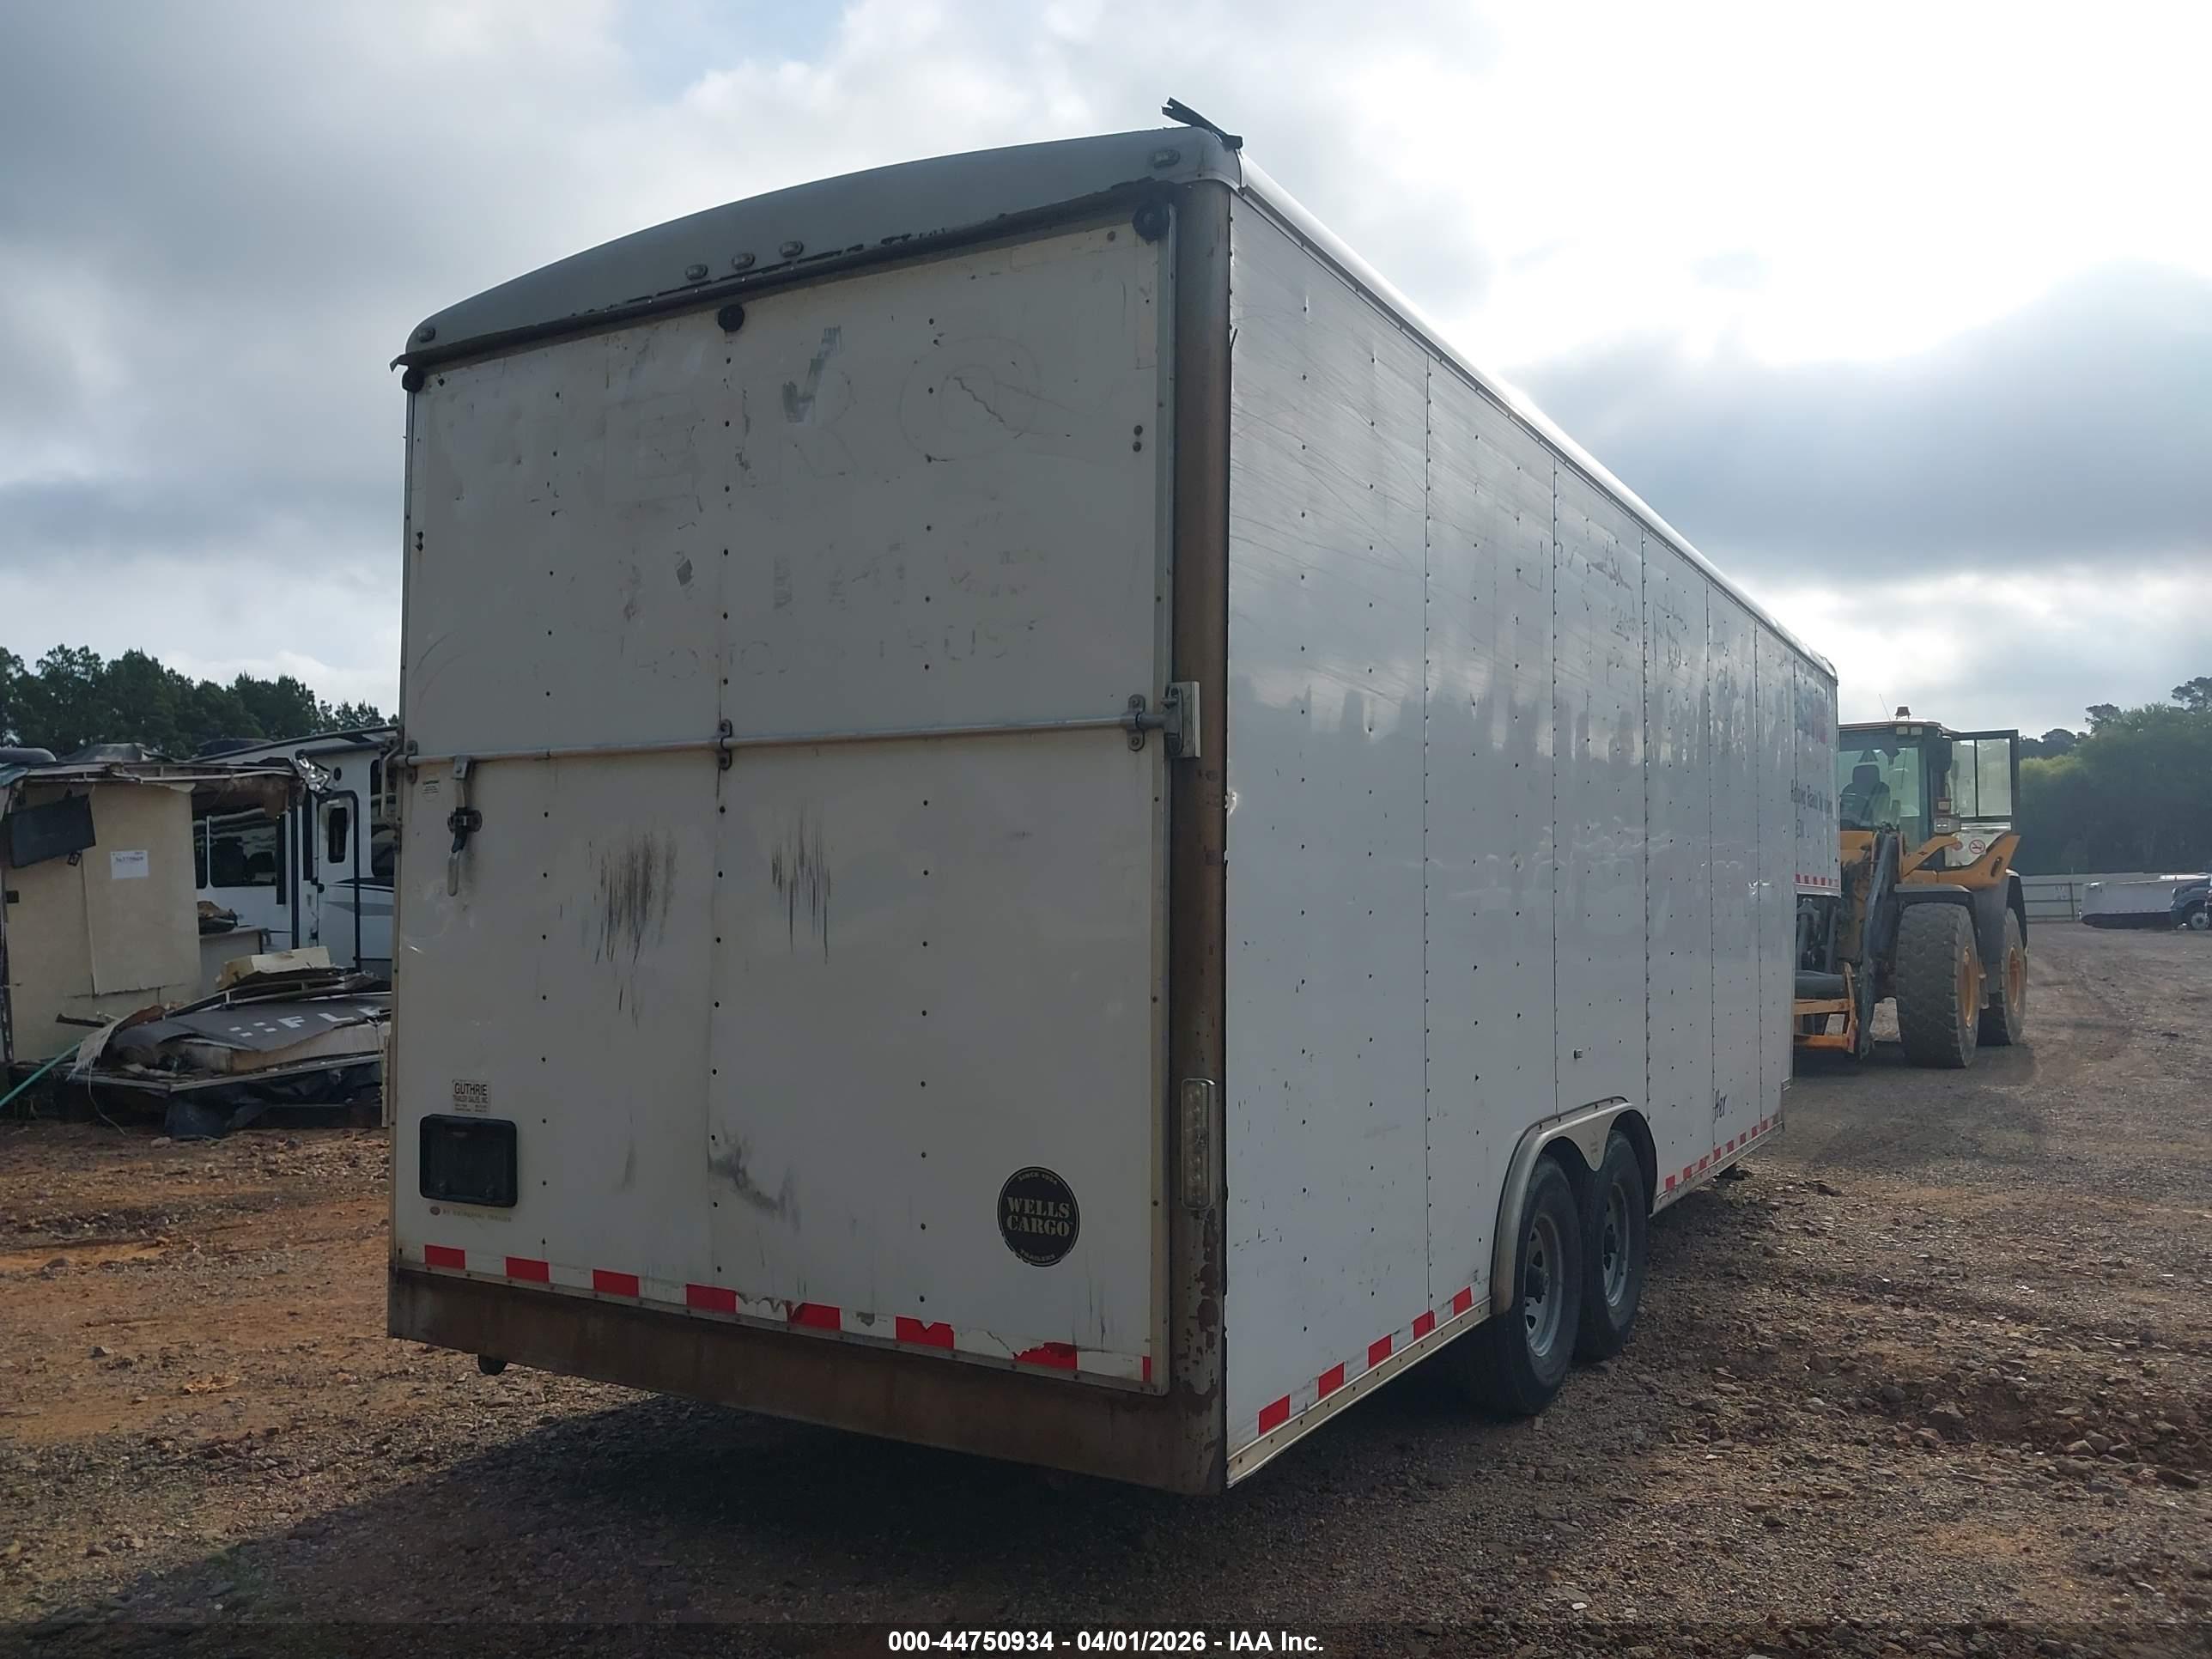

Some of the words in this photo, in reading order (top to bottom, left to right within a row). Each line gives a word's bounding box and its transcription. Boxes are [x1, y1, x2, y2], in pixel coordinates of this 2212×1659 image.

[454, 1082, 487, 1096] GUTHRIE
[1018, 1172, 1040, 1182] SINCE
[1006, 1196, 1071, 1218] WELLS
[1006, 1216, 1070, 1237] CARGO
